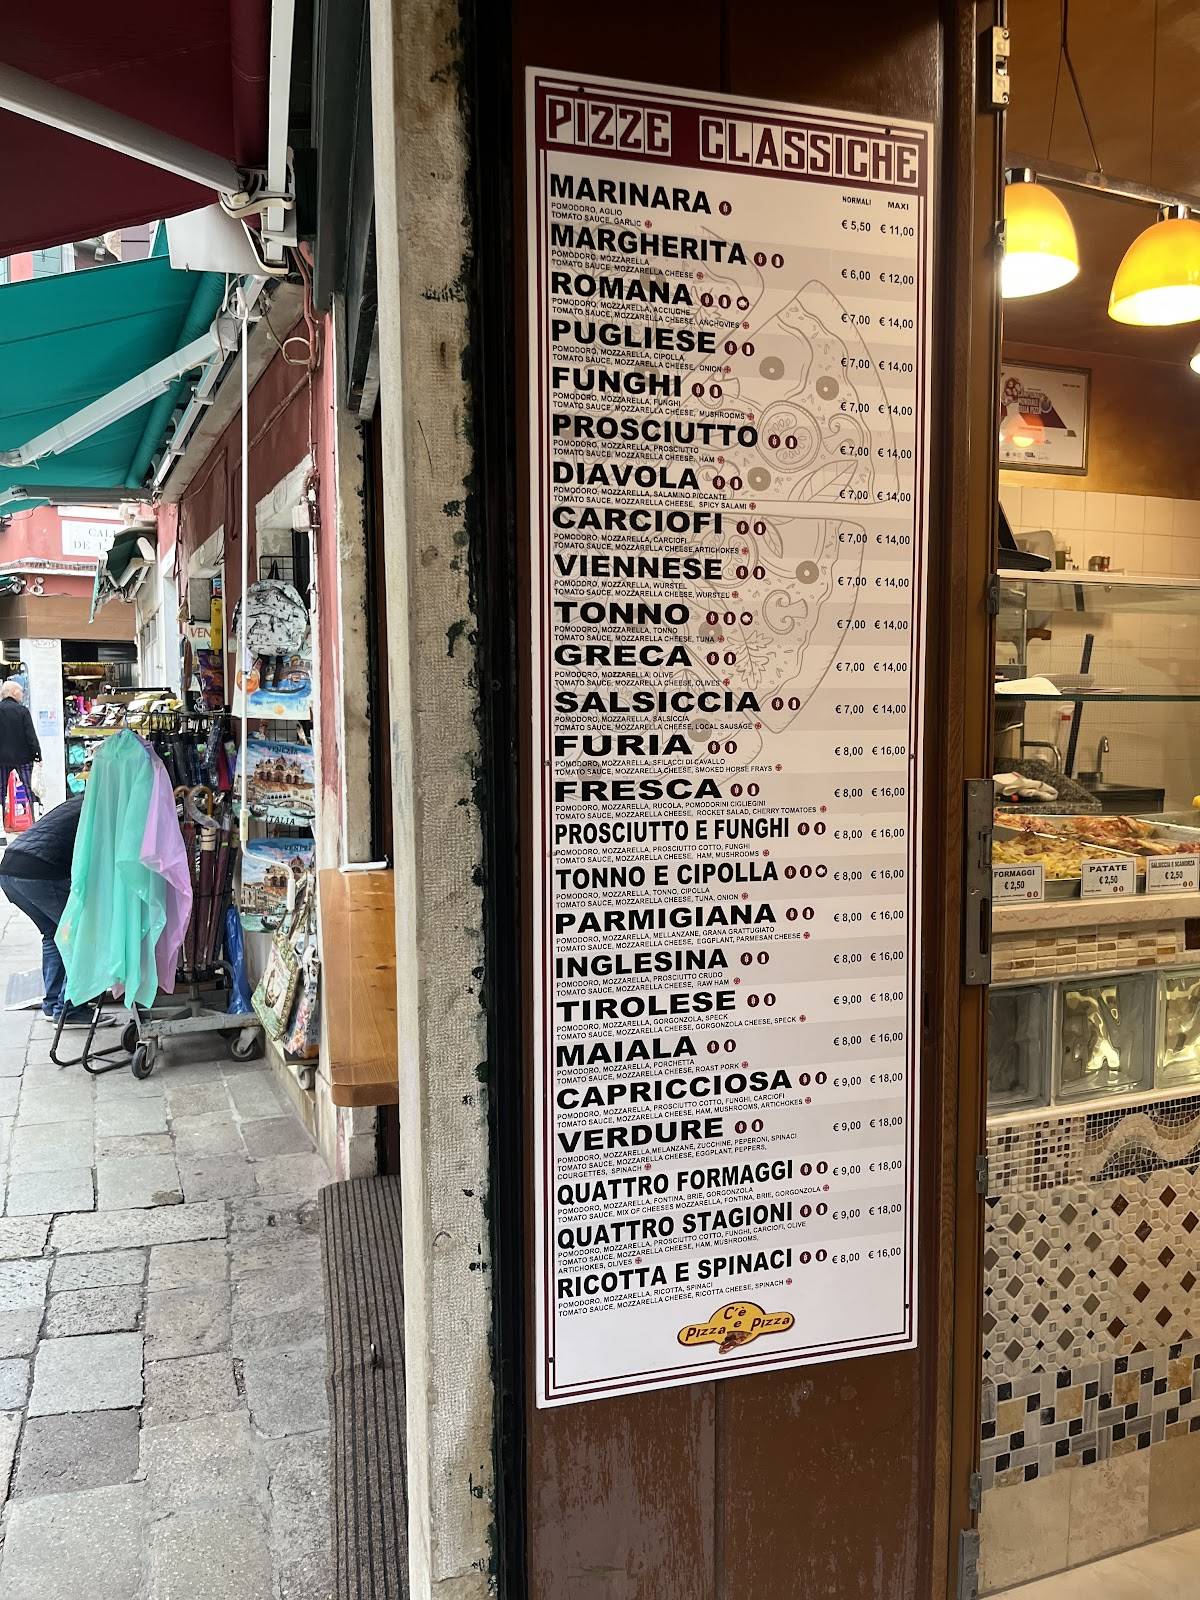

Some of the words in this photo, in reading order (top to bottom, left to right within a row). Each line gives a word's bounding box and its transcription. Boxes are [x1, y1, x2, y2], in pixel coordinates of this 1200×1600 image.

[547, 97, 671, 156] PIZZE
[700, 116, 919, 187] CLASSICHE
[550, 173, 711, 214] MARINARA
[600, 207, 622, 216] AGLIO
[842, 196, 871, 206] NORMALI
[887, 201, 909, 211] MAXI
[552, 211, 582, 220] TOMATO
[614, 217, 641, 227] GARLIC
[841, 219, 848, 230] €
[851, 220, 871, 232] 5,50
[880, 224, 886, 234] €
[889, 225, 914, 237] 11,00
[551, 223, 746, 265] MARGHERITA
[841, 268, 848, 279] €
[850, 269, 871, 281] 6,00
[879, 272, 885, 283] €
[888, 273, 914, 285] 12,00
[552, 271, 693, 306] ROMANA
[552, 319, 716, 354] PUGLIESE
[553, 367, 681, 397] FUNGHI
[840, 401, 847, 411] €
[849, 402, 870, 414] 7,00
[878, 404, 885, 414] €
[887, 405, 913, 416] 14,00
[553, 414, 758, 447] PROSCIUTTO
[553, 461, 700, 490] DIAVOLA
[553, 506, 722, 534] CARCIOFI
[554, 554, 722, 580] VIENNESE
[554, 602, 689, 625] TONNO
[555, 644, 692, 666] GRECA
[836, 662, 842, 672] €
[845, 662, 865, 672] 7,00
[873, 662, 880, 672] €
[882, 662, 907, 672] 14,00
[554, 692, 760, 713] SALSICCIA
[555, 734, 692, 756] FURIA
[834, 746, 841, 756] €
[843, 746, 864, 756] 8,00
[872, 746, 878, 755] €
[880, 746, 906, 755] 16,00
[555, 779, 722, 802] FRESCA
[265, 815, 296, 825] ITALIA
[556, 820, 688, 844] PROSCIUTTO
[696, 820, 707, 840] E
[715, 818, 788, 839] FUNGHI
[556, 866, 645, 889] TONNO
[655, 865, 668, 885] E
[677, 861, 778, 884] CIPOLLA
[833, 871, 840, 881] €
[842, 871, 862, 881] 8,00
[870, 870, 877, 879] €
[879, 869, 904, 879] 16,00
[993, 869, 1035, 878] FORMAGGI
[1089, 864, 1128, 873] PATATE
[1170, 870, 1184, 881] 2,50
[1004, 881, 1009, 890] €
[1010, 880, 1025, 891] 2,50
[1099, 875, 1104, 885] €
[1104, 875, 1118, 885] 2,50
[556, 904, 776, 934] PARMIGIANA
[833, 913, 840, 922] €
[842, 912, 862, 922] 8,00
[870, 911, 877, 921] €
[880, 910, 904, 920] 16,00
[728, 926, 775, 935] GRATTUGIATO
[556, 949, 728, 978] INGLESINA
[557, 990, 735, 1022] TIROLESE
[833, 995, 840, 1005] €
[842, 994, 862, 1005] 9,00
[870, 993, 876, 1003] €
[879, 991, 904, 1002] 18,00
[833, 1037, 840, 1046] €
[842, 1035, 862, 1046] 8,00
[870, 1034, 876, 1043] €
[878, 1032, 903, 1042] 16,00
[557, 1036, 697, 1067] MAIALA
[654, 1059, 695, 1068] PORCHETTA
[557, 1076, 587, 1084] TOMATO
[616, 1070, 663, 1080] MOZZARELLA
[557, 1070, 792, 1109] CAPRICCIOSA
[833, 1122, 839, 1132] €
[841, 1120, 861, 1131] 9,00
[869, 1119, 876, 1128] €
[878, 1116, 903, 1127] 18,00
[558, 1117, 723, 1153] VERDURE
[558, 1174, 668, 1205] QUATTRO
[678, 1160, 792, 1191] FORMAGGI
[706, 1187, 754, 1197] GORGONZOLA
[558, 1217, 674, 1249] QUATTRO
[683, 1202, 792, 1233] STAGIONI
[832, 1255, 838, 1264] €
[840, 1252, 860, 1263] 8,00
[868, 1250, 874, 1259] €
[877, 1247, 901, 1258] 16,00
[558, 1266, 667, 1299] RICOTTA
[676, 1262, 689, 1282] E
[698, 1248, 791, 1279] SPINACI
[686, 1282, 713, 1291] SPINACI
[733, 1320, 742, 1328] e
